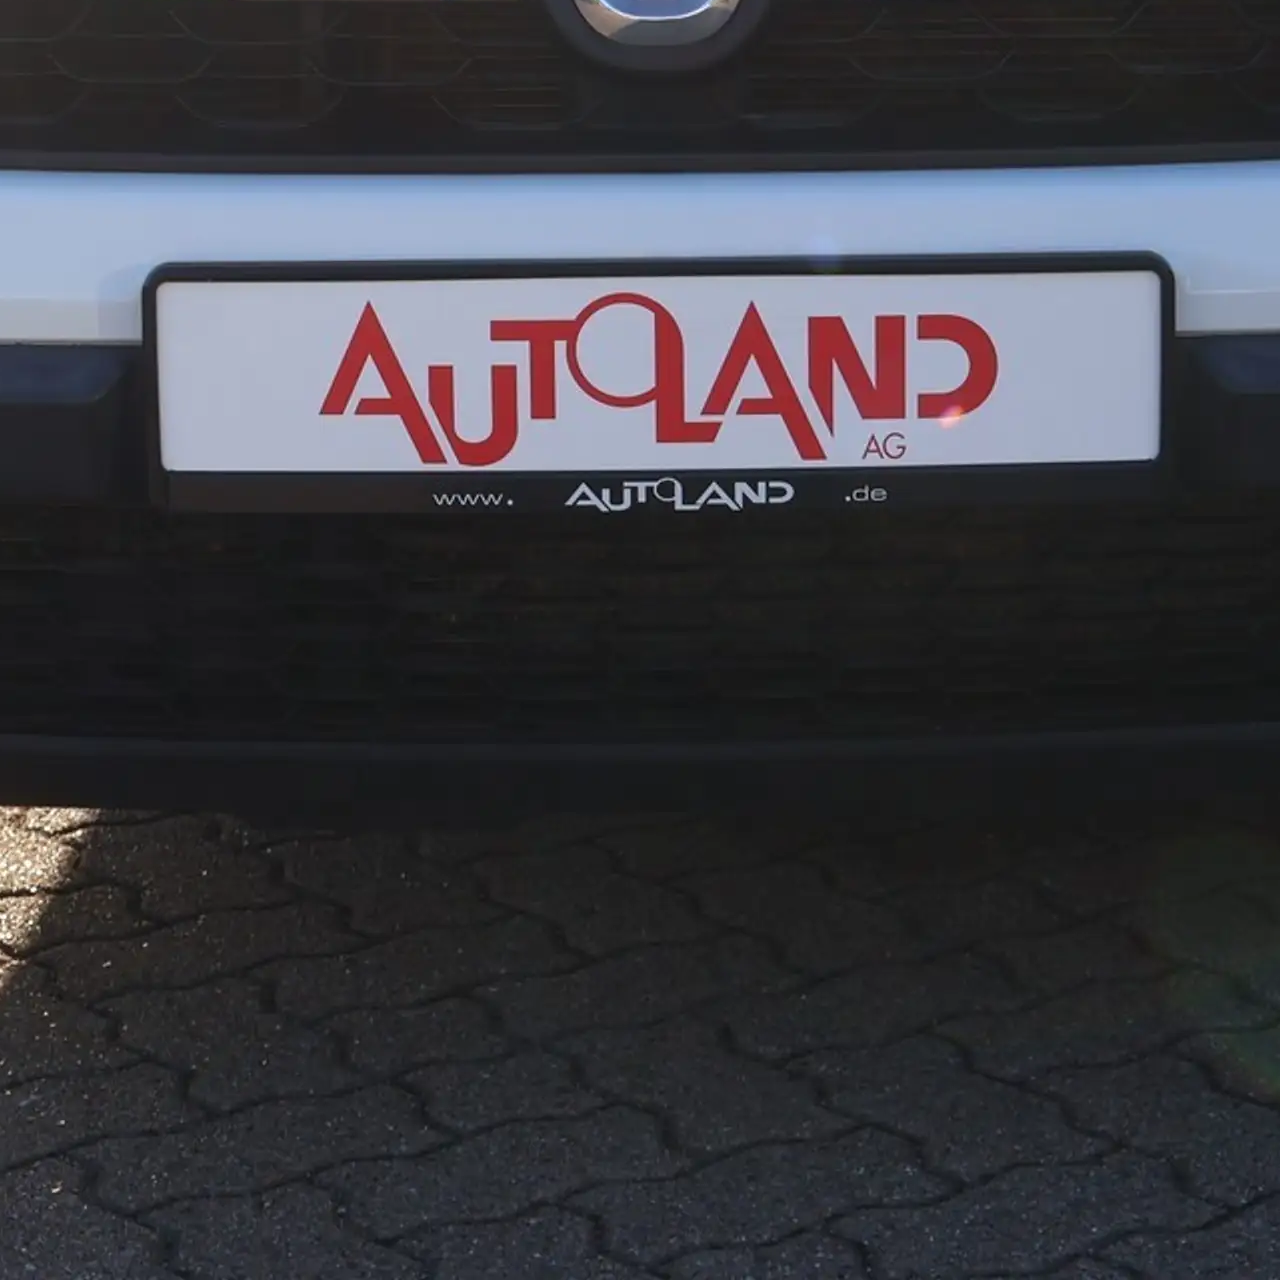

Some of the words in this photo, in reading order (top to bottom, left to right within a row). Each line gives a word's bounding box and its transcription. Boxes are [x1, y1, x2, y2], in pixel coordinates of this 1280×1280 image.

[862, 431, 907, 460] AG
[432, 491, 514, 507] www.
[844, 485, 888, 502] .de
